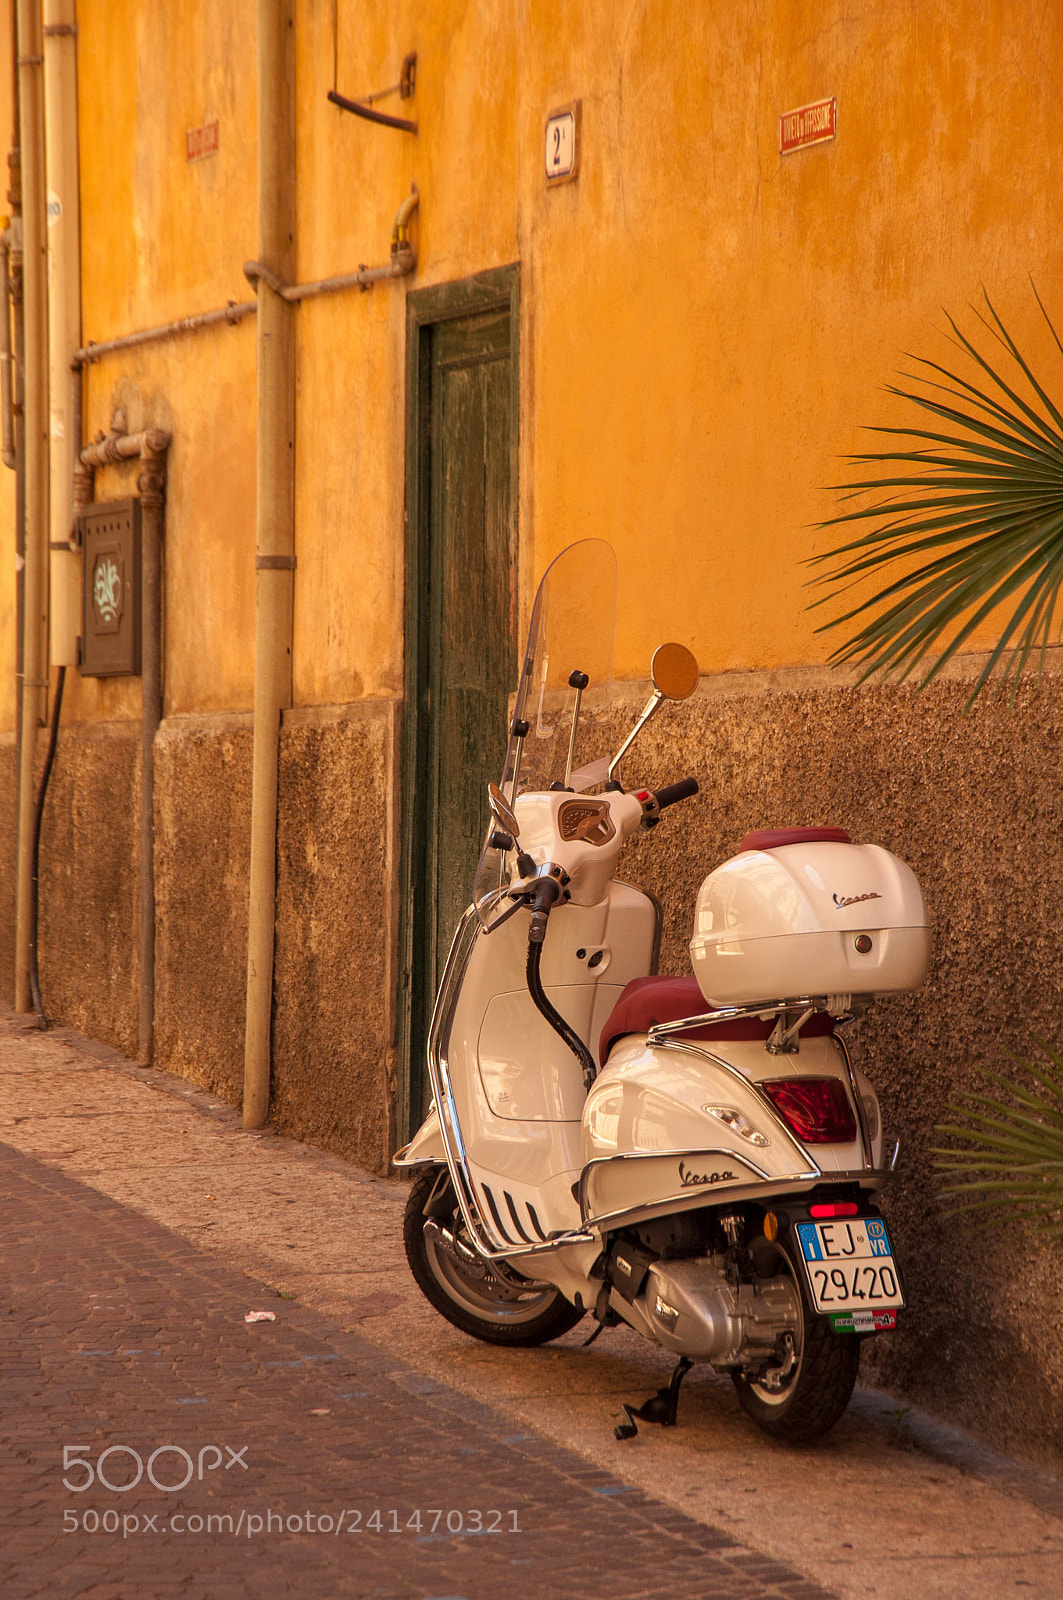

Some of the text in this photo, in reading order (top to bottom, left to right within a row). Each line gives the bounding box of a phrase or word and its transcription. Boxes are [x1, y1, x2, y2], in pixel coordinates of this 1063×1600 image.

[832, 892, 882, 909] Vespa
[678, 1160, 739, 1187] Vespa
[871, 1225, 880, 1235] 17
[819, 1223, 855, 1257] EJ
[869, 1238, 888, 1255] VR
[808, 1242, 816, 1259] I
[814, 1266, 898, 1302] 29420
